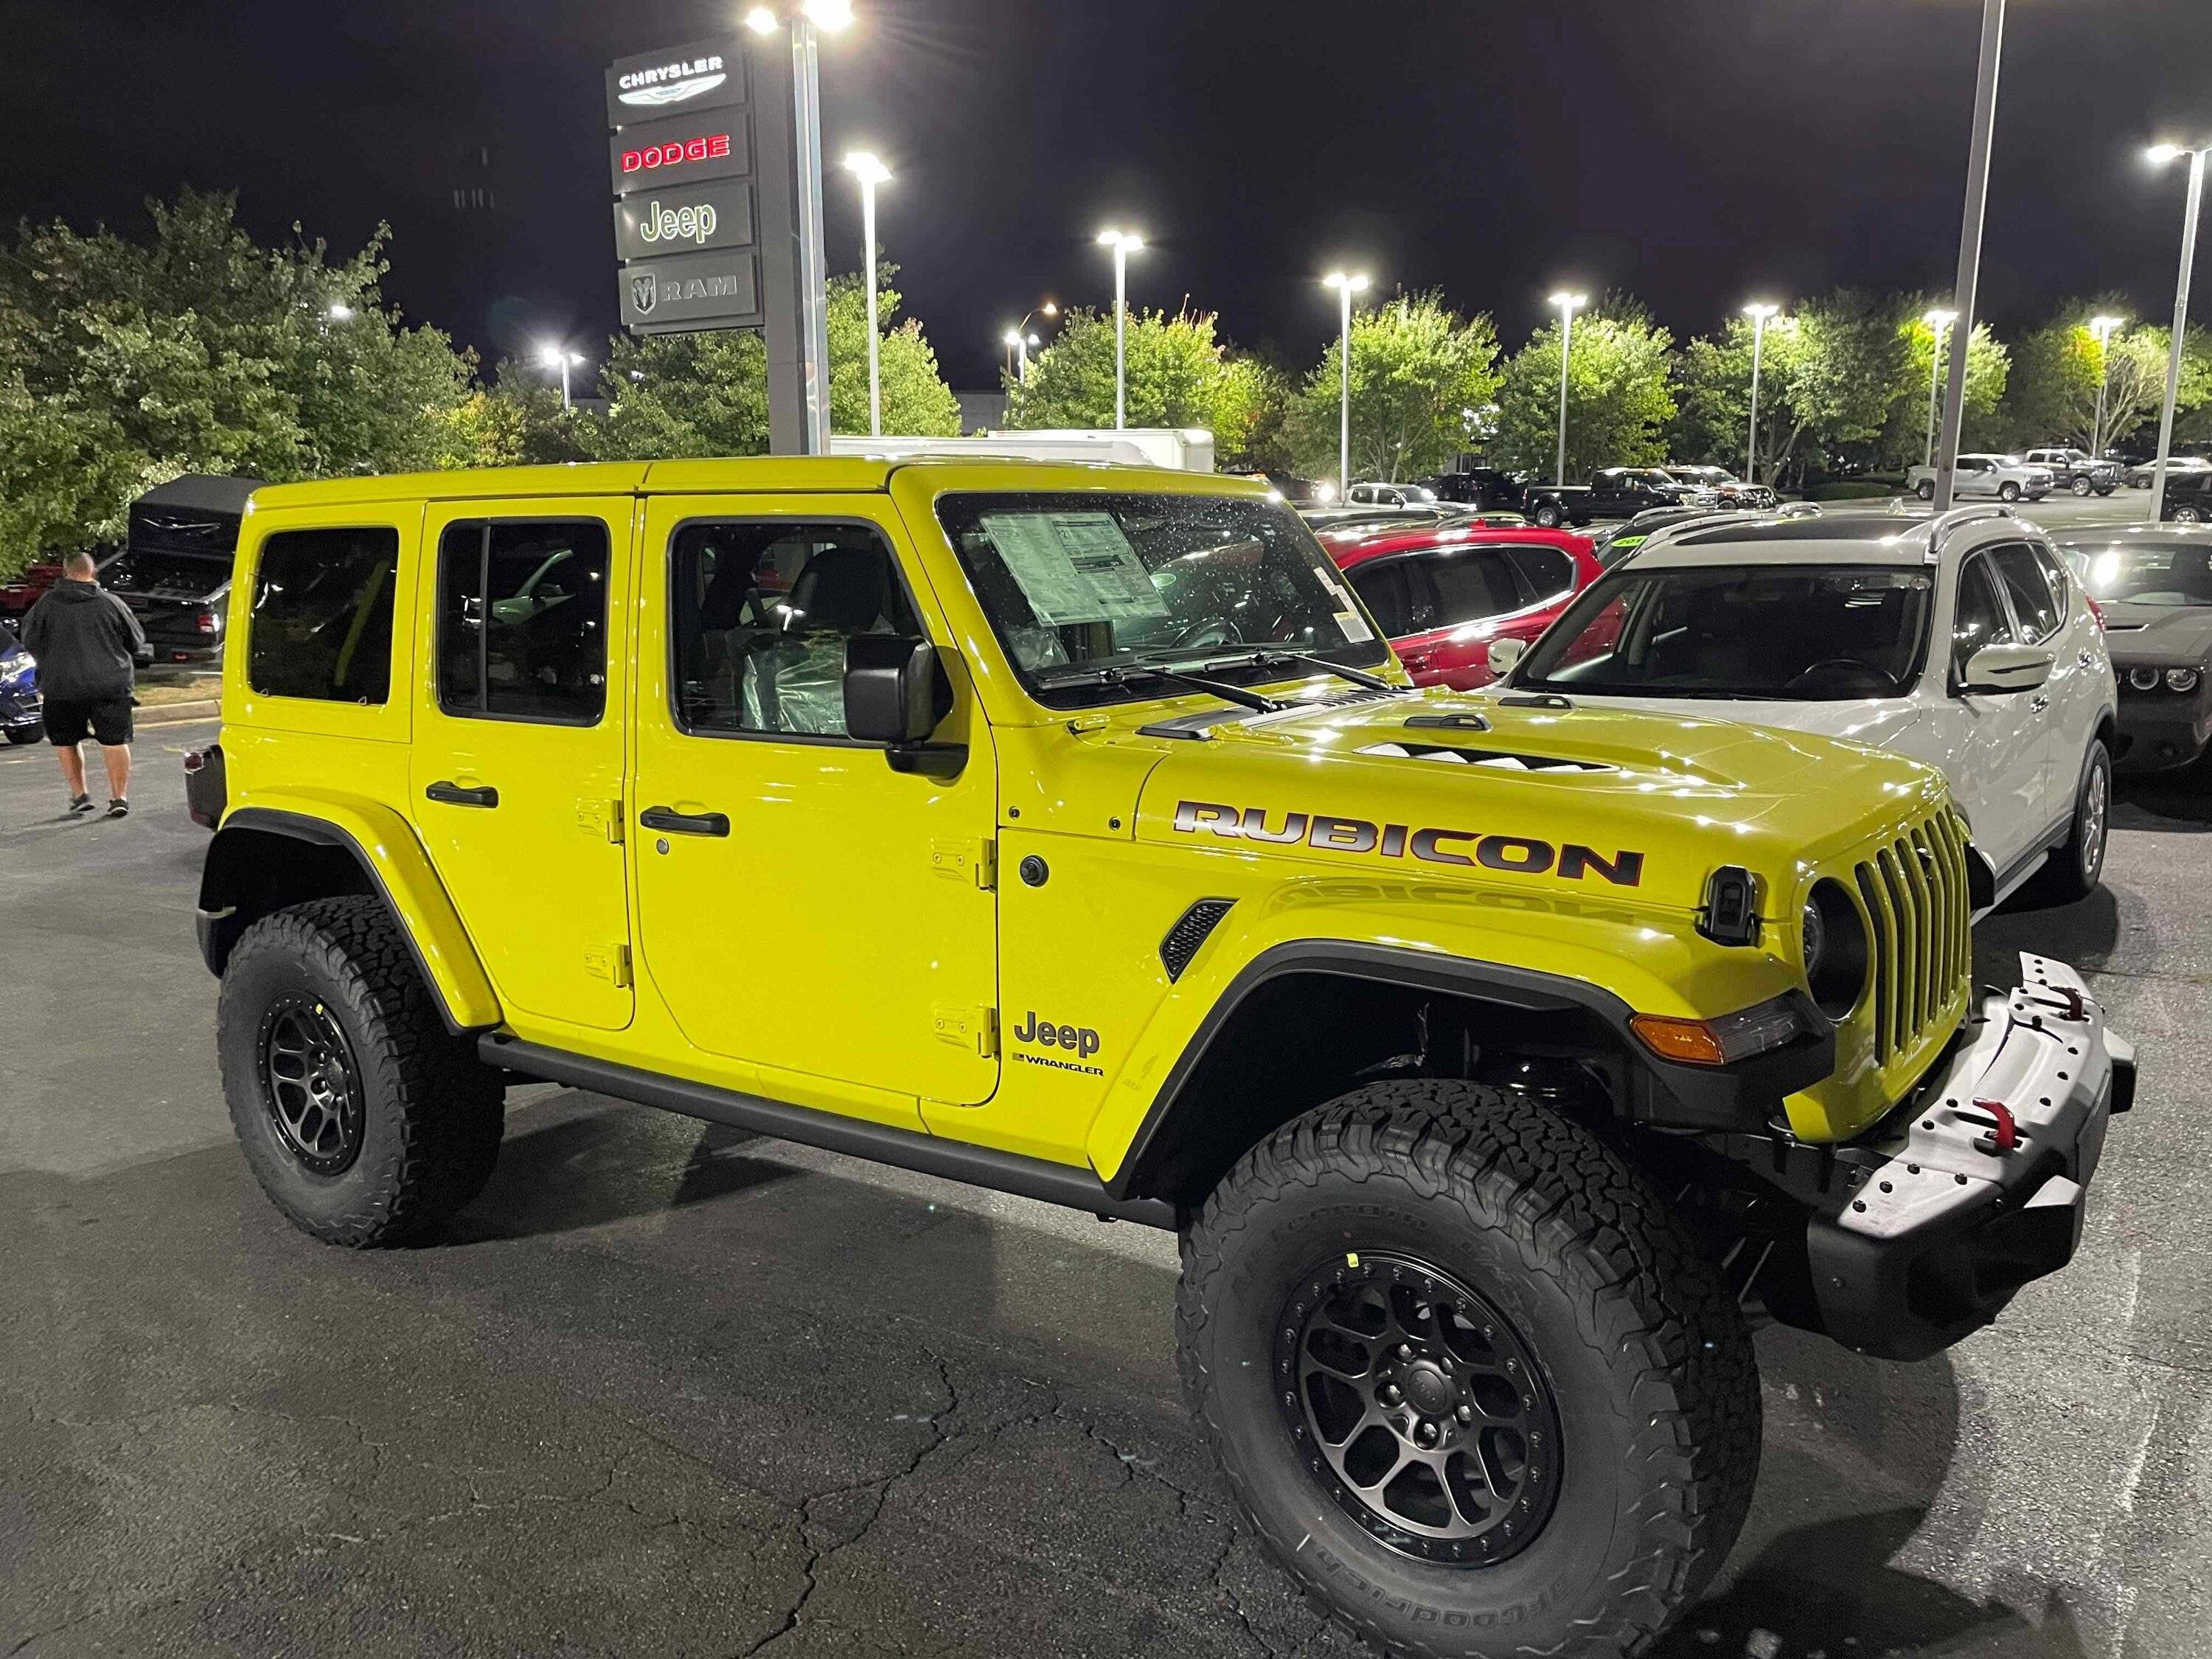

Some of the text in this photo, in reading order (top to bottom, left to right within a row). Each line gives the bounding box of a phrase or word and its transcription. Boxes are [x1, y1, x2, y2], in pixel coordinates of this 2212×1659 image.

[619, 55, 723, 89] CHRYSLER
[622, 134, 731, 173] DODGE
[640, 201, 717, 244] Jeep
[663, 275, 738, 302] RAM
[1172, 799, 1645, 888] RUBICON
[1014, 1010, 1100, 1059] Jeep
[1025, 1054, 1105, 1077] WRANGLER
